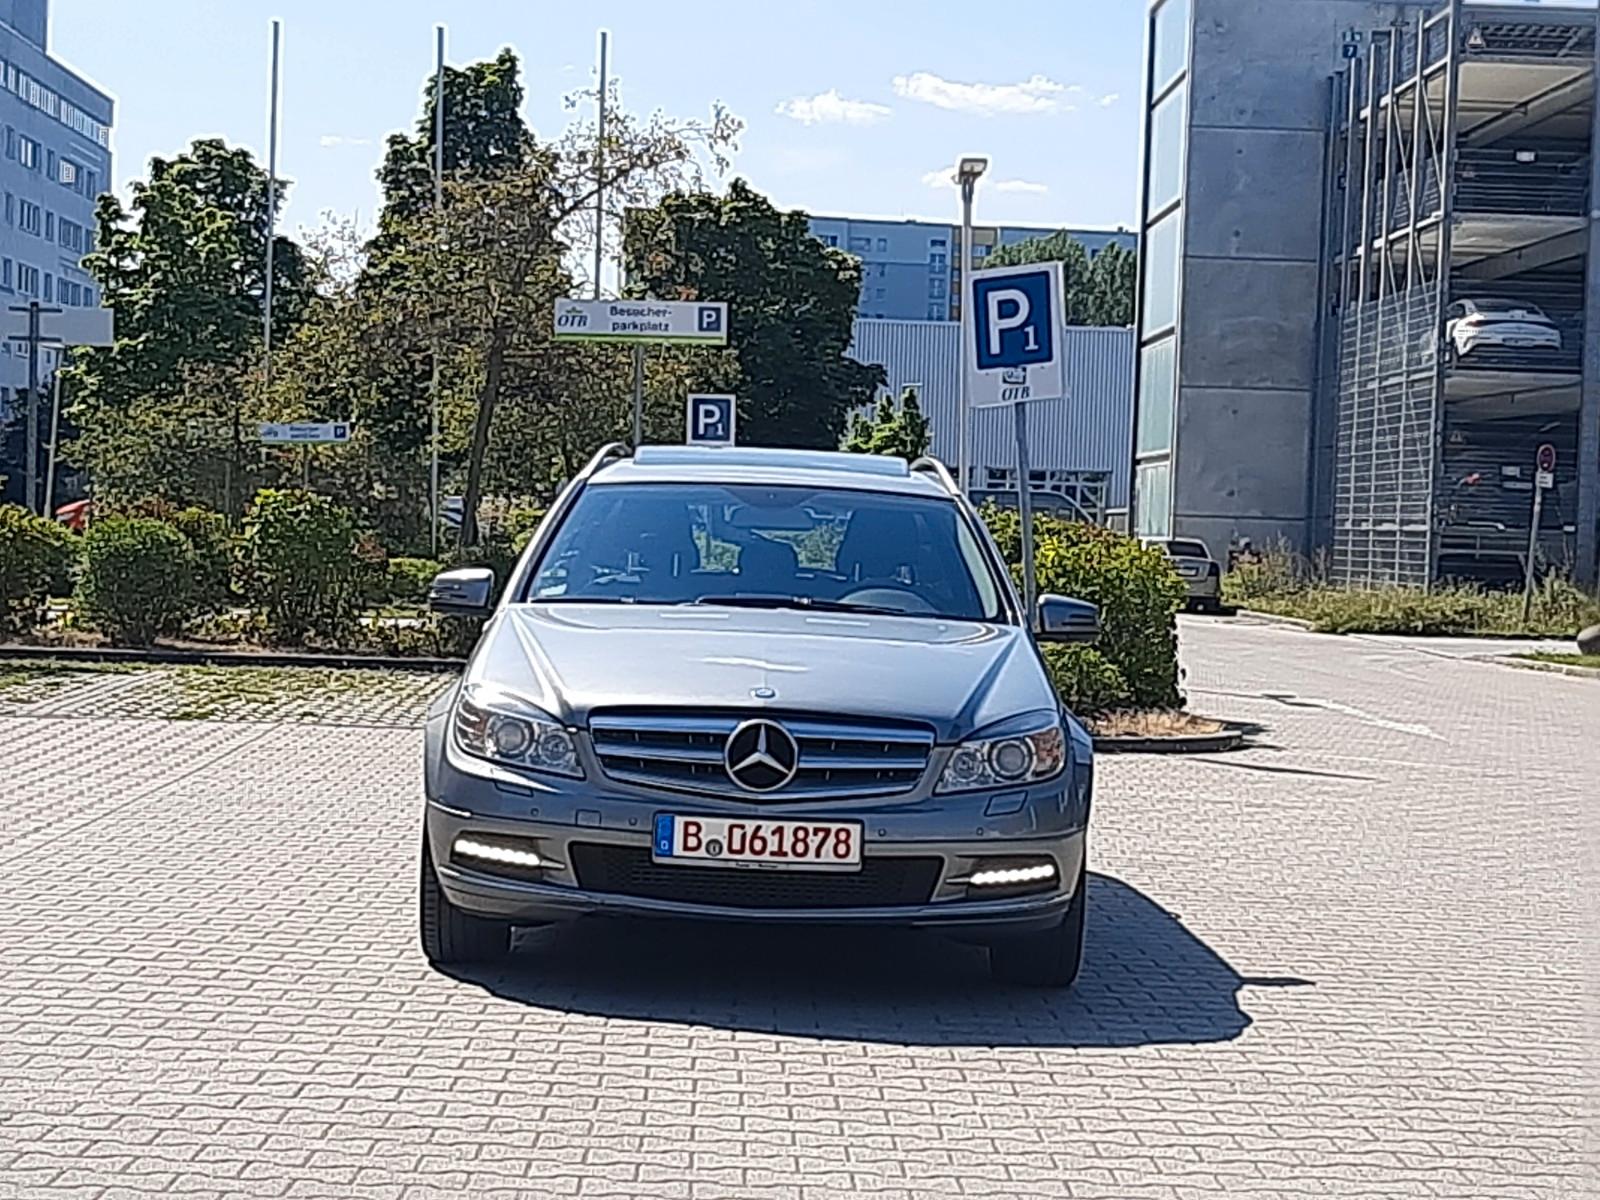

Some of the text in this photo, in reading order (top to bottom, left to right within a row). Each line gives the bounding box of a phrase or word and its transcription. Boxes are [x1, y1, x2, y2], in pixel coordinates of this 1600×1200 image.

[609, 305, 672, 318] Besucher-
[612, 321, 669, 332] parkplatz
[703, 311, 716, 328] P
[682, 820, 851, 859] B 061878
